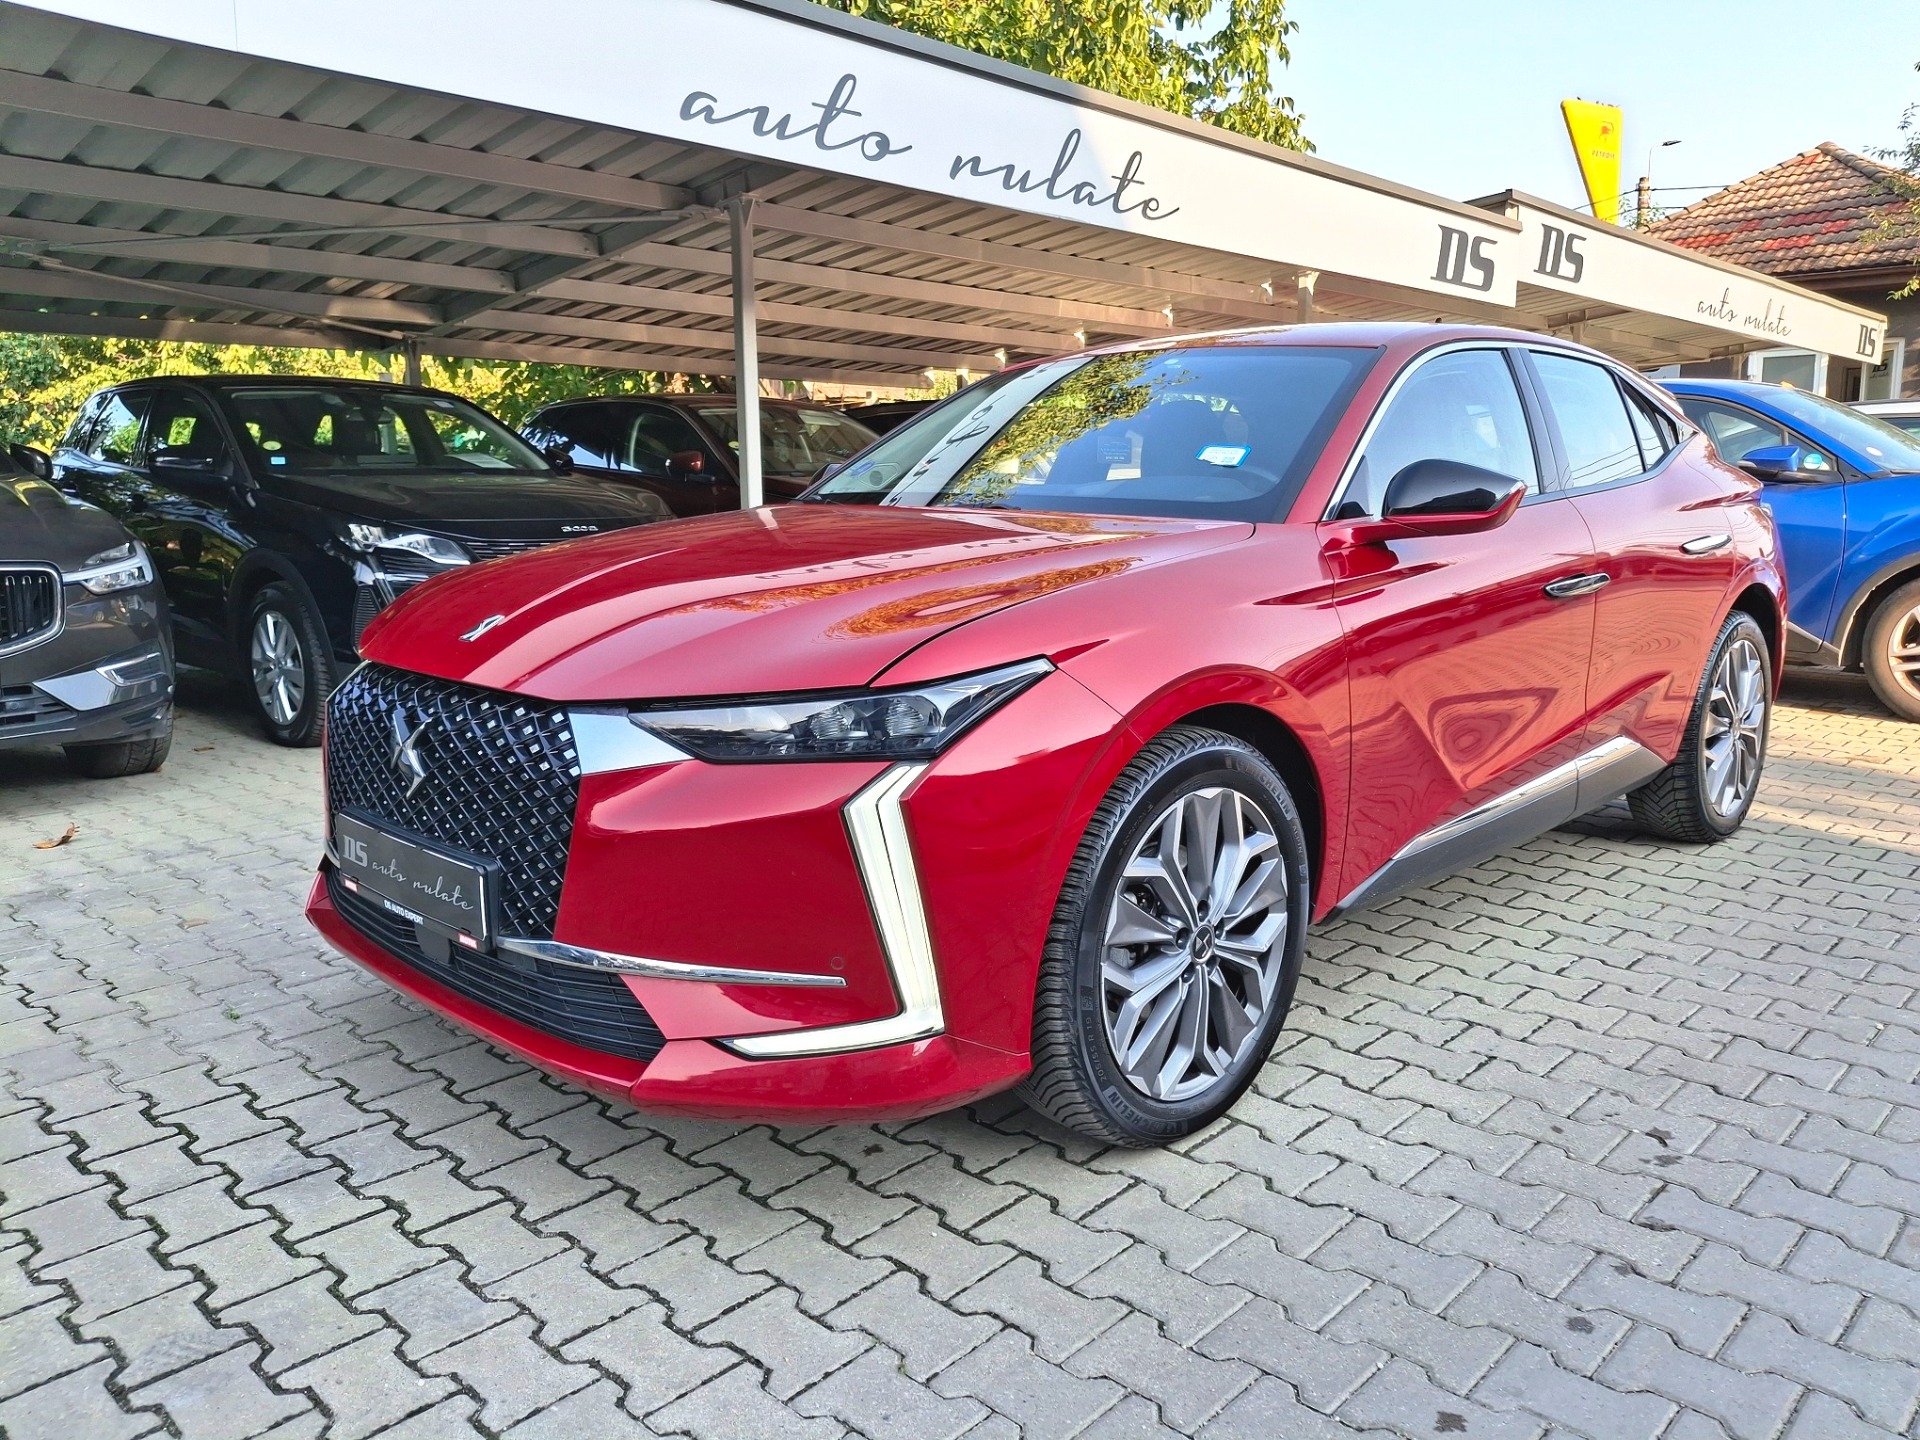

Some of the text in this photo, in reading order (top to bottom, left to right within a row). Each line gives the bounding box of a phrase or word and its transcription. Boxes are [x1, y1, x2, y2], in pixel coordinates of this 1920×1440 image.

[680, 73, 912, 161] auto
[1431, 224, 1498, 292] DS
[1533, 223, 1587, 283] DS
[1697, 287, 1738, 322] auto
[1856, 323, 1877, 358] DS
[342, 834, 368, 867] DS
[372, 858, 407, 882] auto
[391, 903, 405, 917] AUTO
